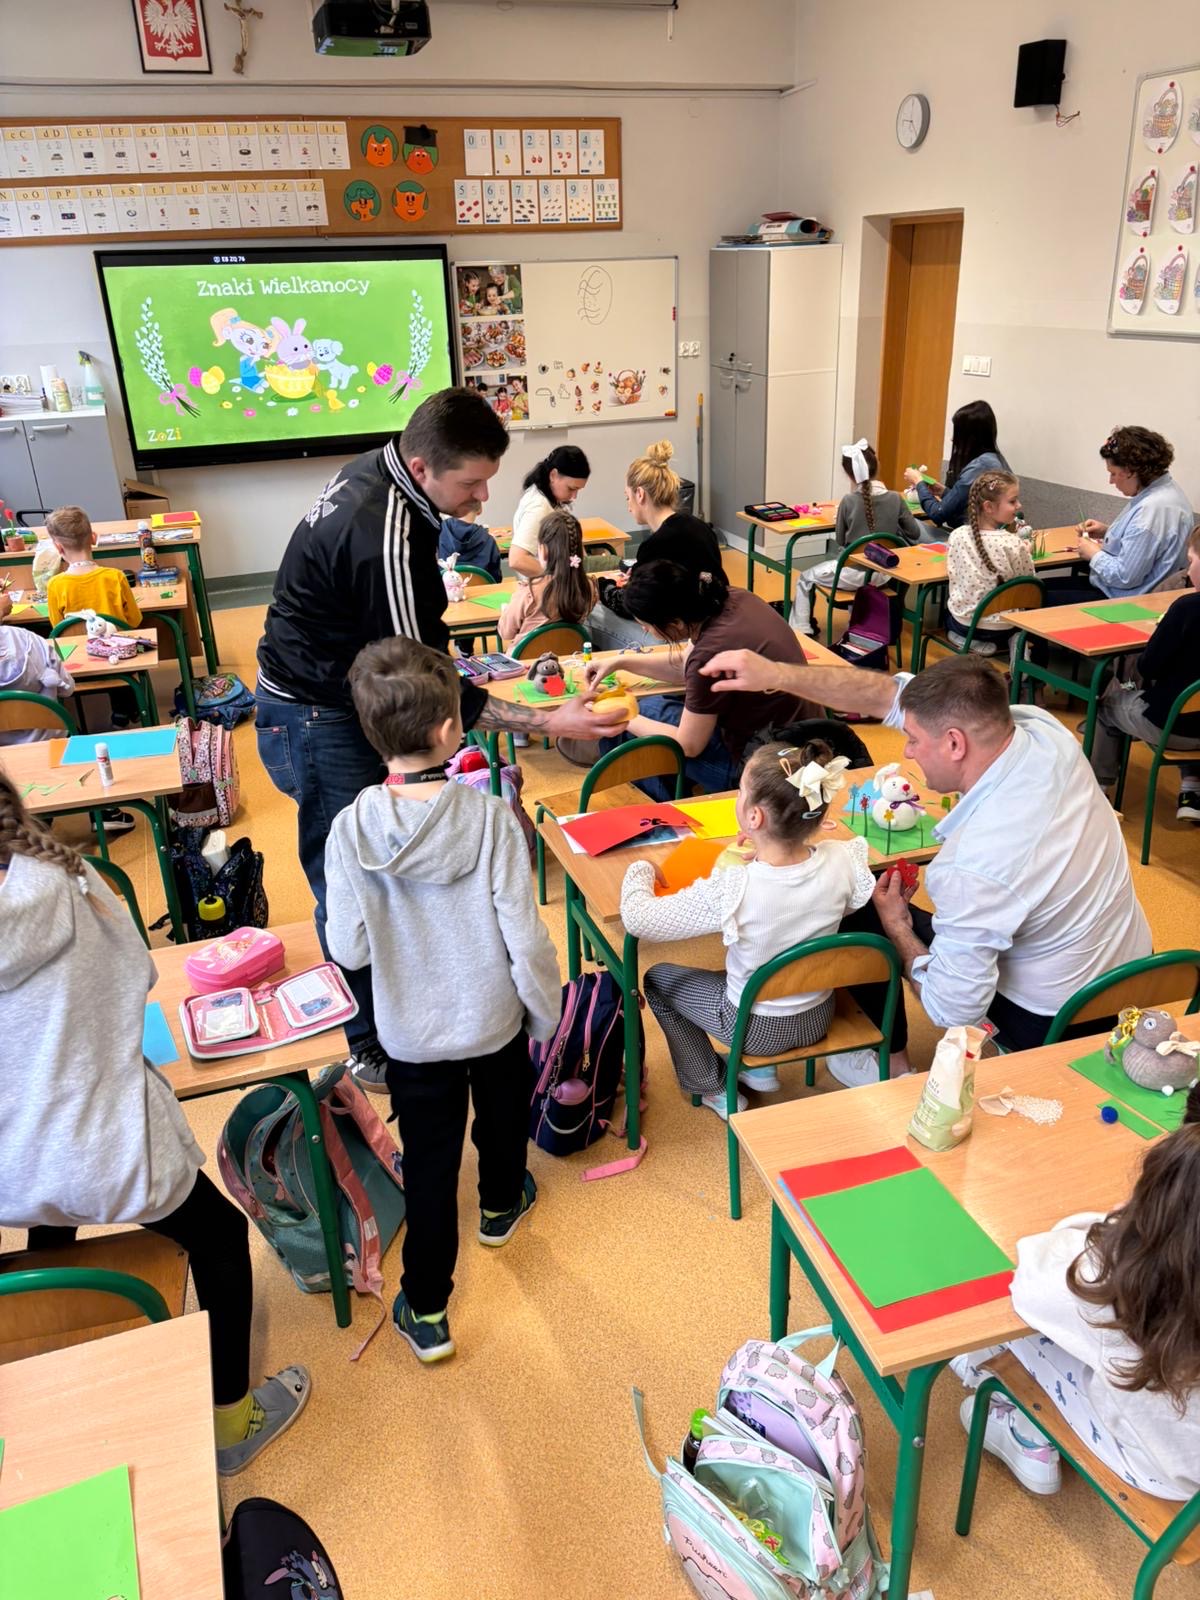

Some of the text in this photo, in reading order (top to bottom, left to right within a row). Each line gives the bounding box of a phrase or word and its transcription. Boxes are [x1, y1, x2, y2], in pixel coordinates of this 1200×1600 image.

[468, 135, 475, 145] 0
[499, 135, 503, 145] 1
[526, 135, 533, 145] 2
[555, 135, 561, 145] 3
[582, 135, 588, 145] 4
[459, 185, 465, 194] 5
[487, 185, 493, 194] 6
[515, 185, 521, 194] 7
[543, 185, 549, 194] 8
[570, 185, 577, 194] 9
[596, 184, 605, 192] 10
[196, 277, 255, 297] Znaki
